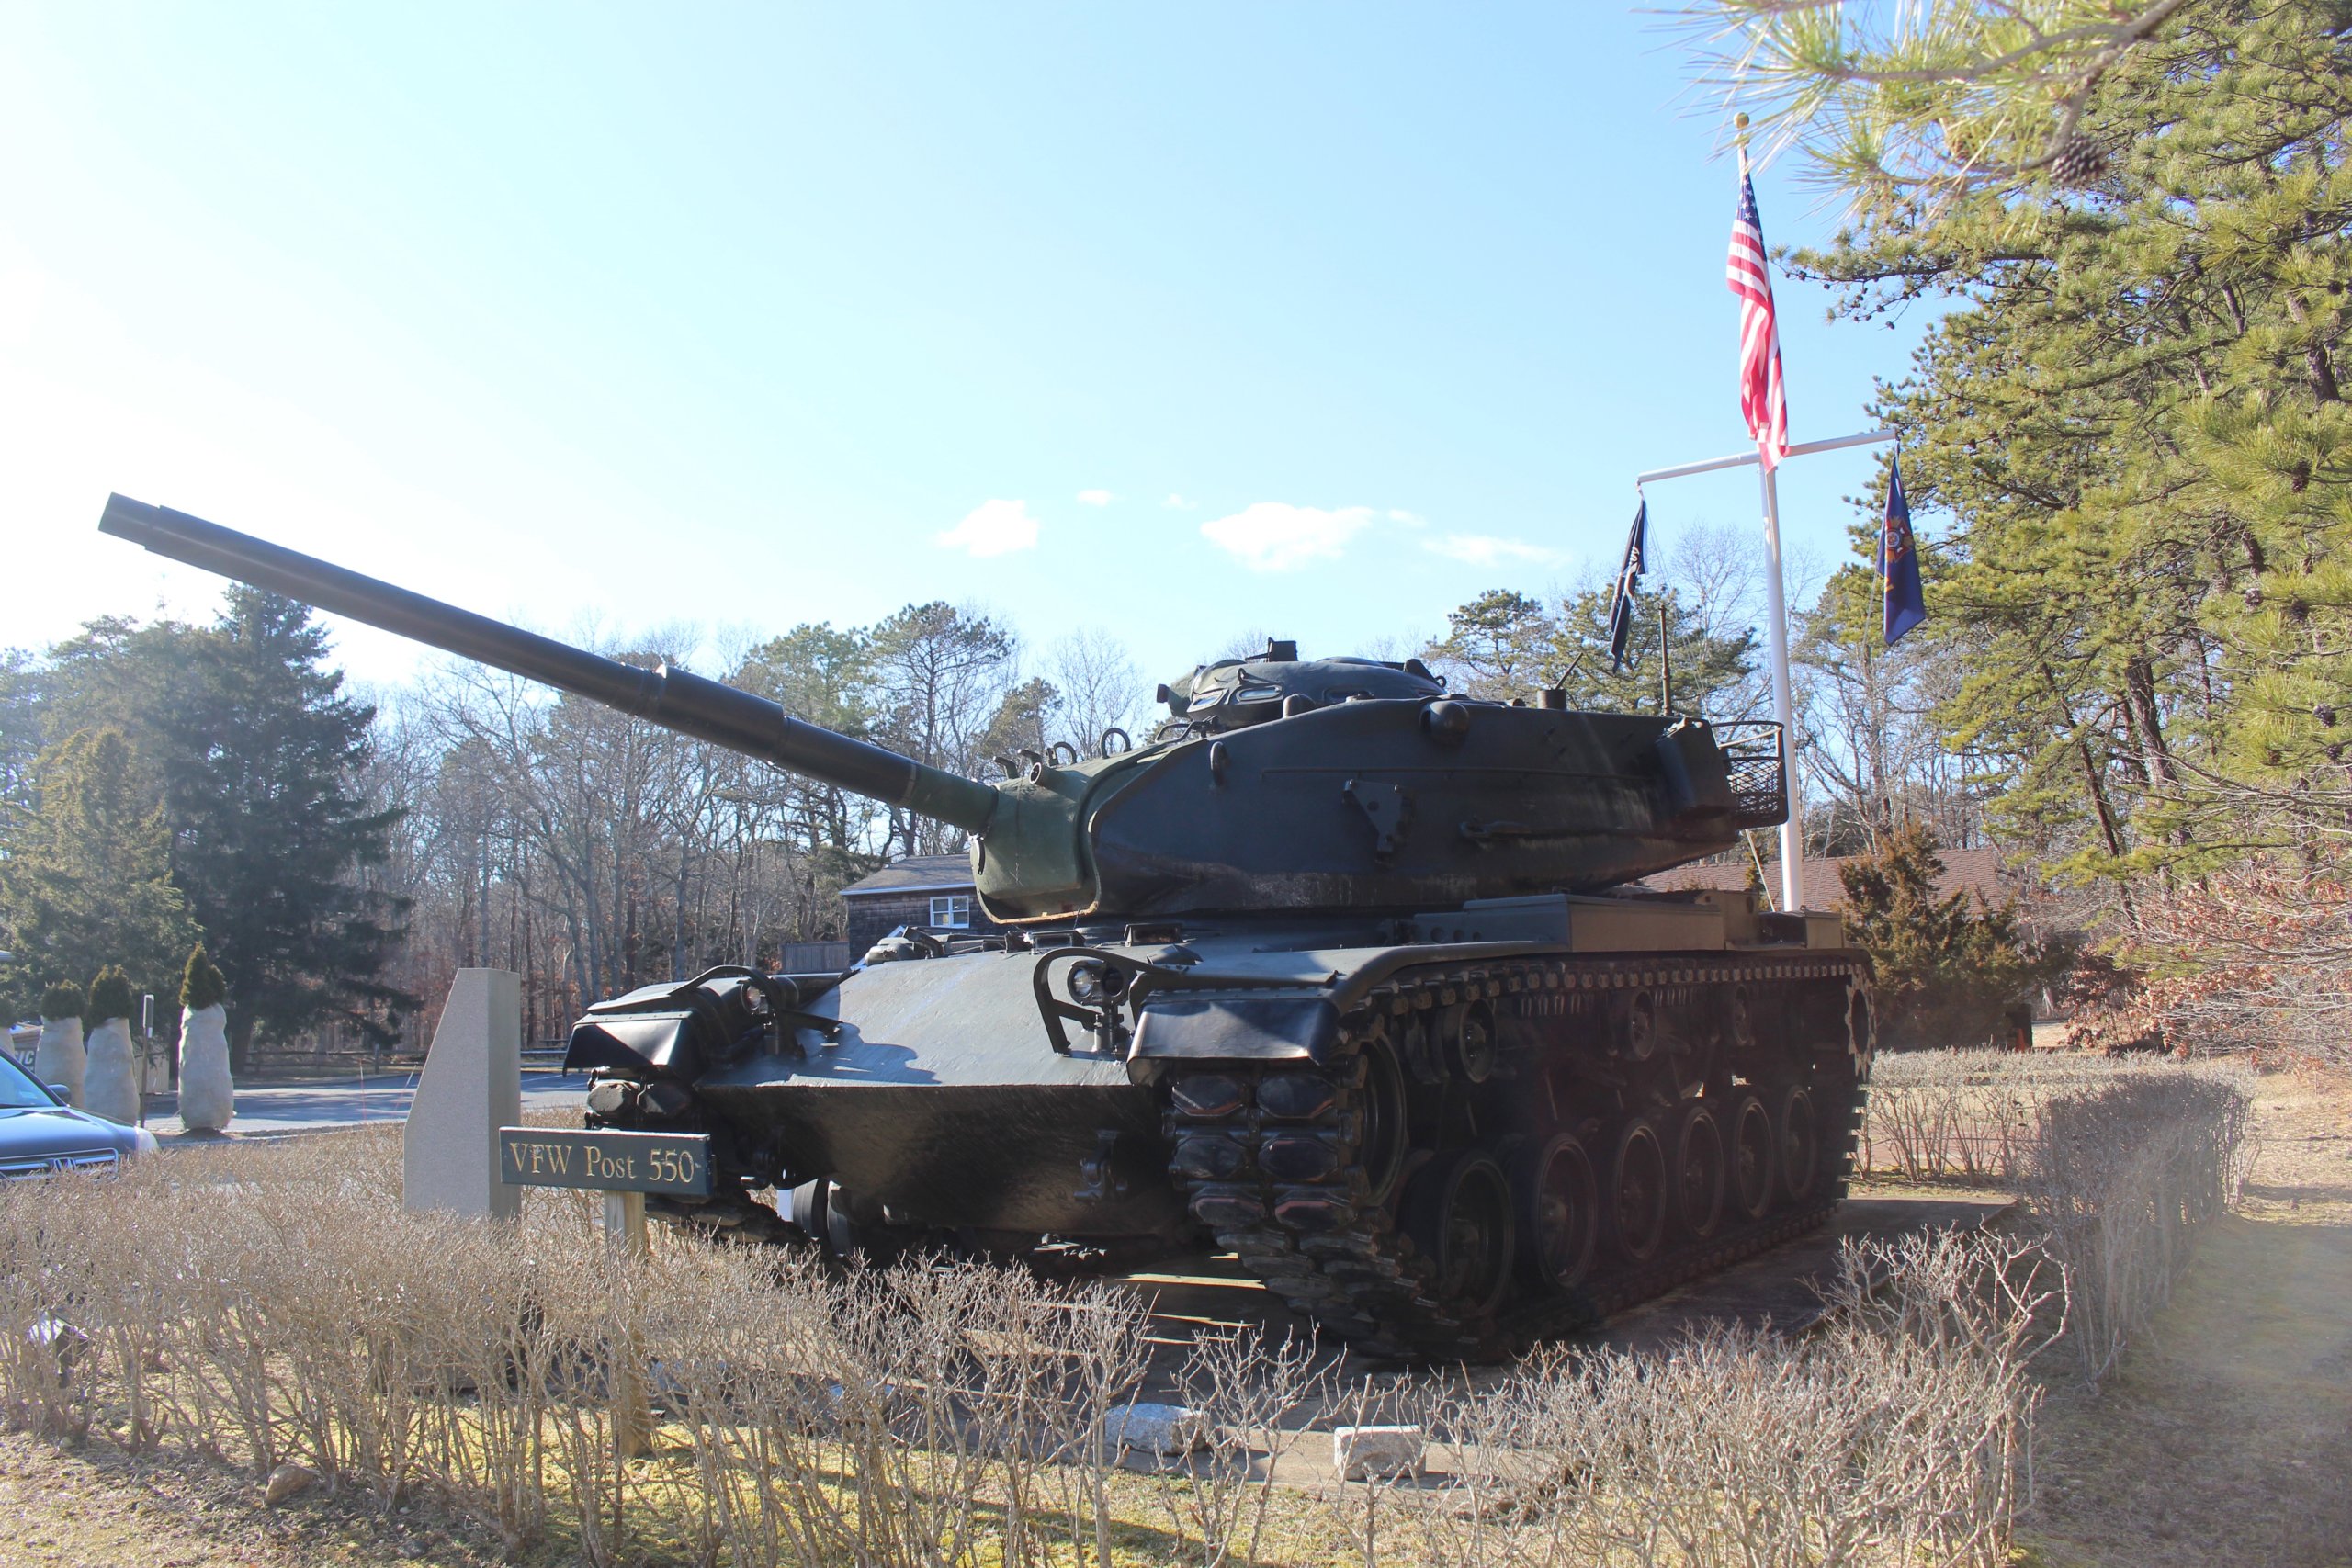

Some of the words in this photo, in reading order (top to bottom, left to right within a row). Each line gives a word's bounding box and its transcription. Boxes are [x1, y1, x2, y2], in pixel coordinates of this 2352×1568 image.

[509, 1142, 572, 1175] VFW
[583, 1145, 637, 1179] Post
[649, 1148, 695, 1183] 550
